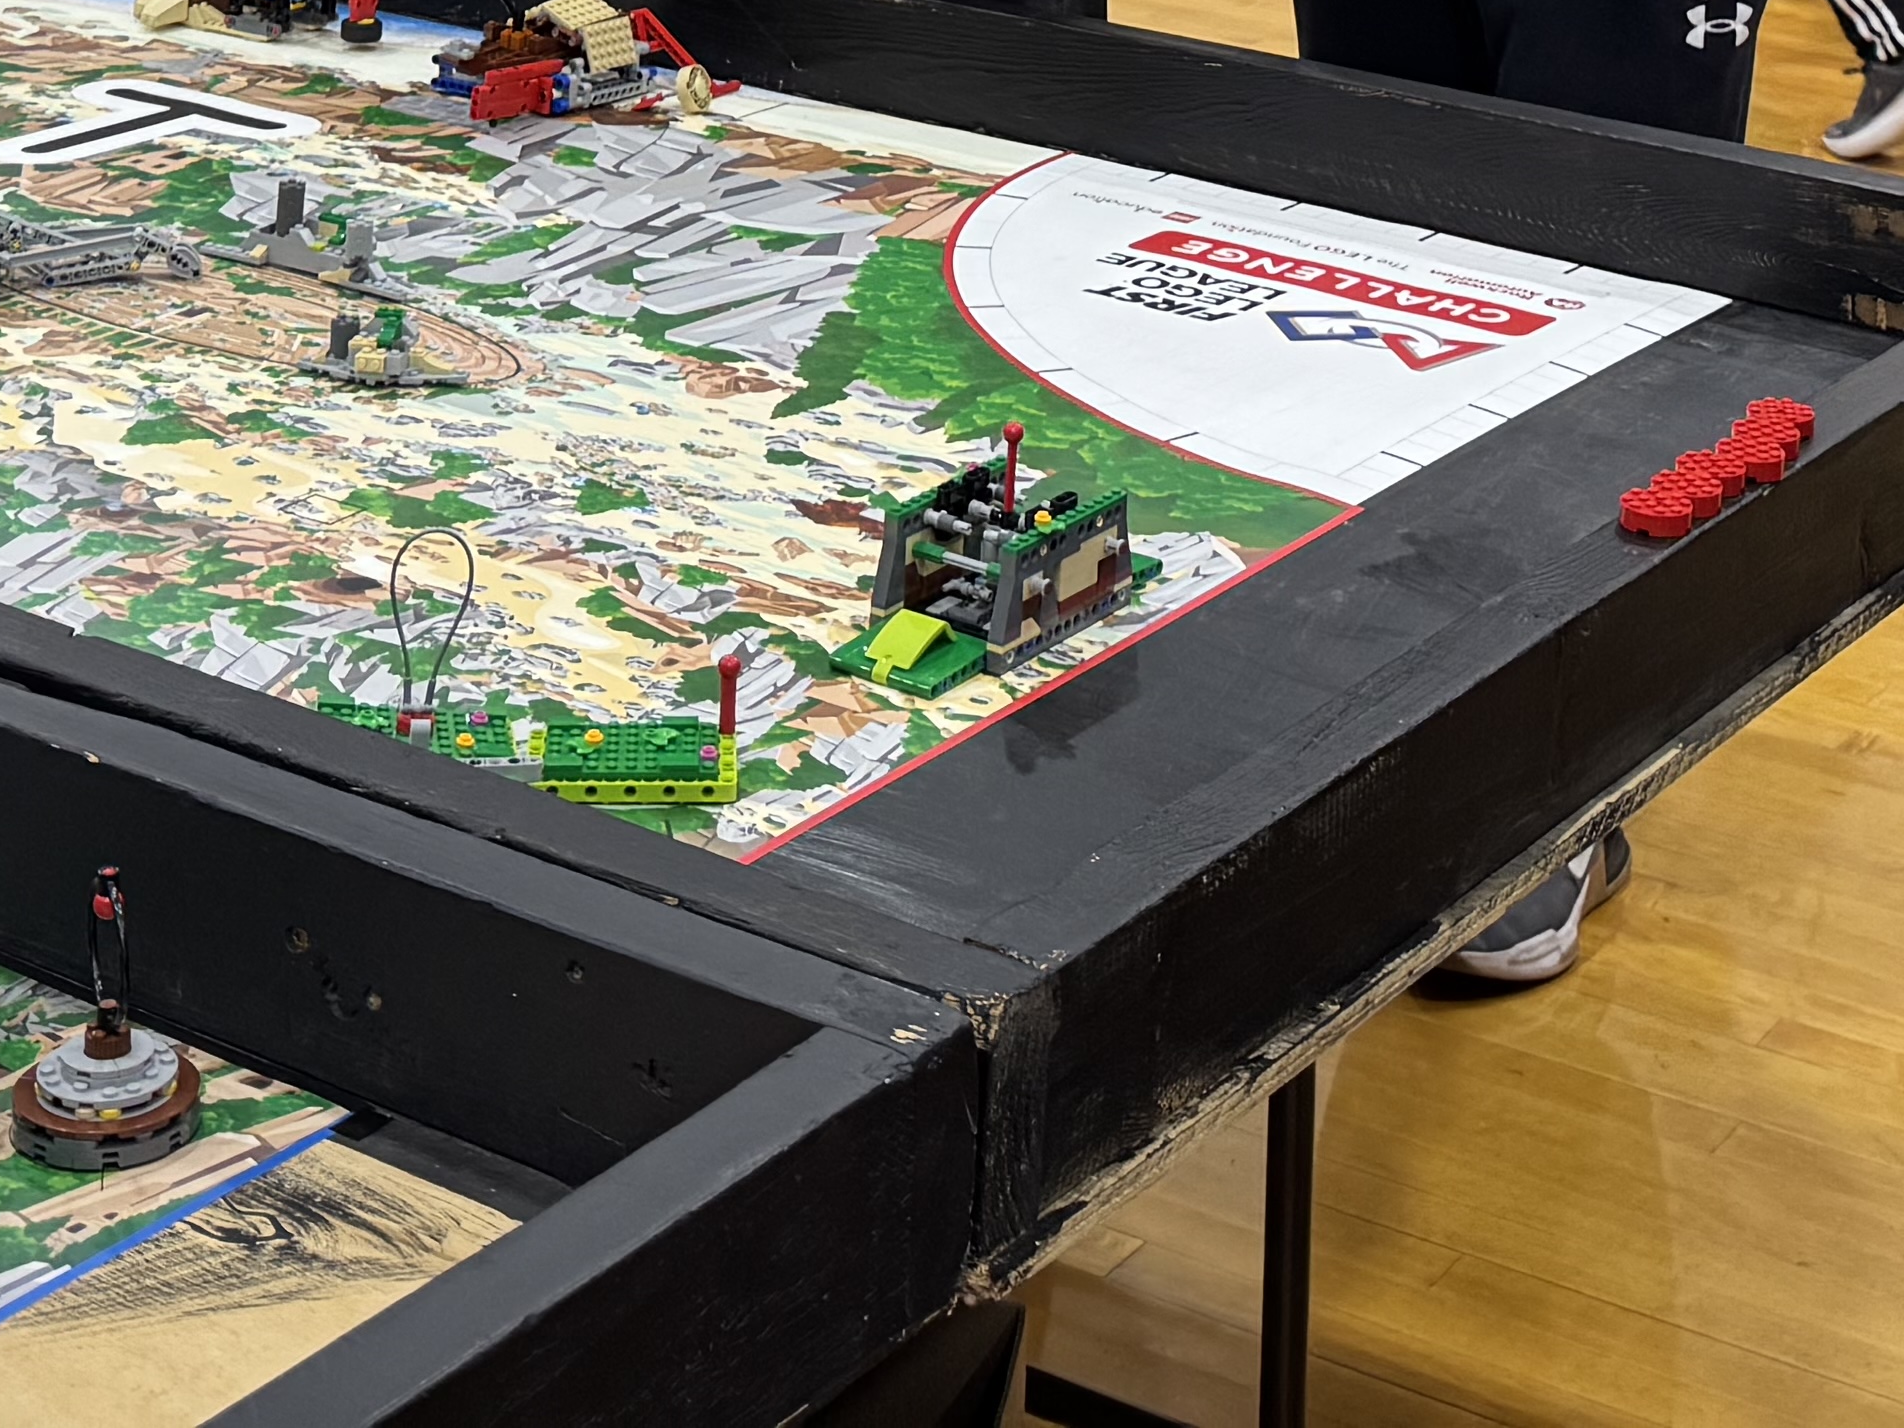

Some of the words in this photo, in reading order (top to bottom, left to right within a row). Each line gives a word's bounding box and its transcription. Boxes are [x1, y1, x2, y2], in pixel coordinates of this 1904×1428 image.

[1095, 252, 1288, 300] LEAGUE
[1131, 276, 1264, 311] LEGO
[1171, 239, 1511, 324] CHALLENGE
[1082, 285, 1238, 322] FIRST
